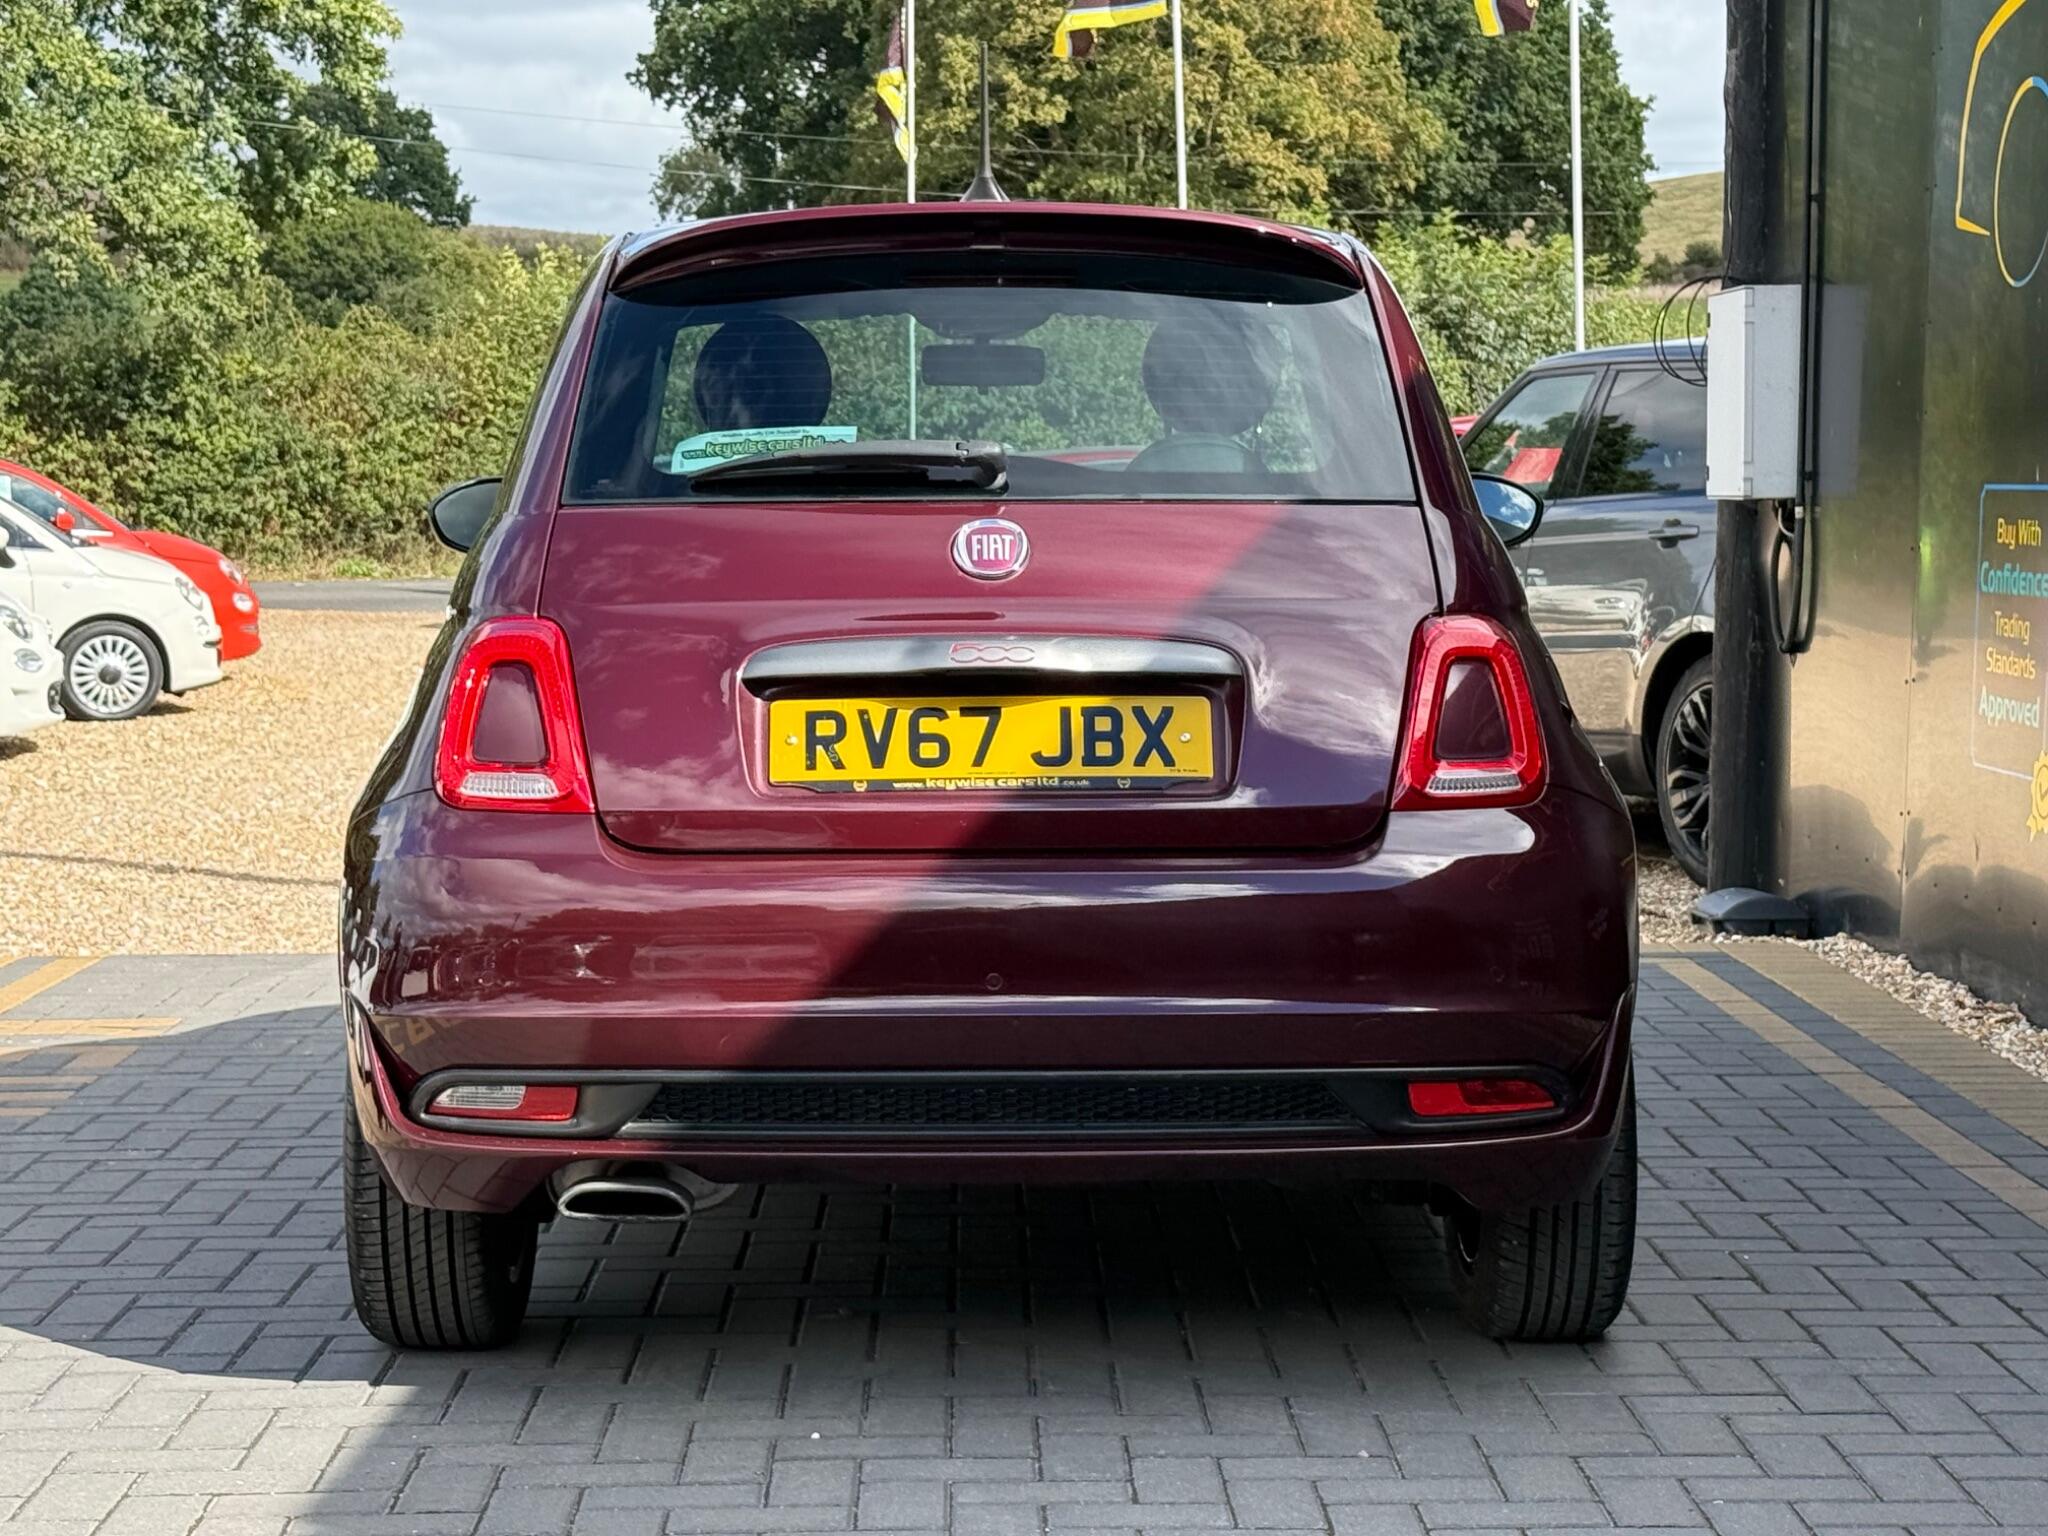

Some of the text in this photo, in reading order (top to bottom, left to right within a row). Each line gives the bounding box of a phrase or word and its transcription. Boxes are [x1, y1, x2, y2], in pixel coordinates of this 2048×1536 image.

[971, 534, 1014, 561] FIAT
[1997, 517, 2042, 549] Buy With
[1980, 561, 2048, 598] Confidence
[1994, 610, 2031, 646] Trading
[950, 643, 1035, 663] 500
[1986, 647, 2036, 680] Standards
[1979, 684, 2040, 728] Approved
[804, 705, 1176, 771] RV67 JBX
